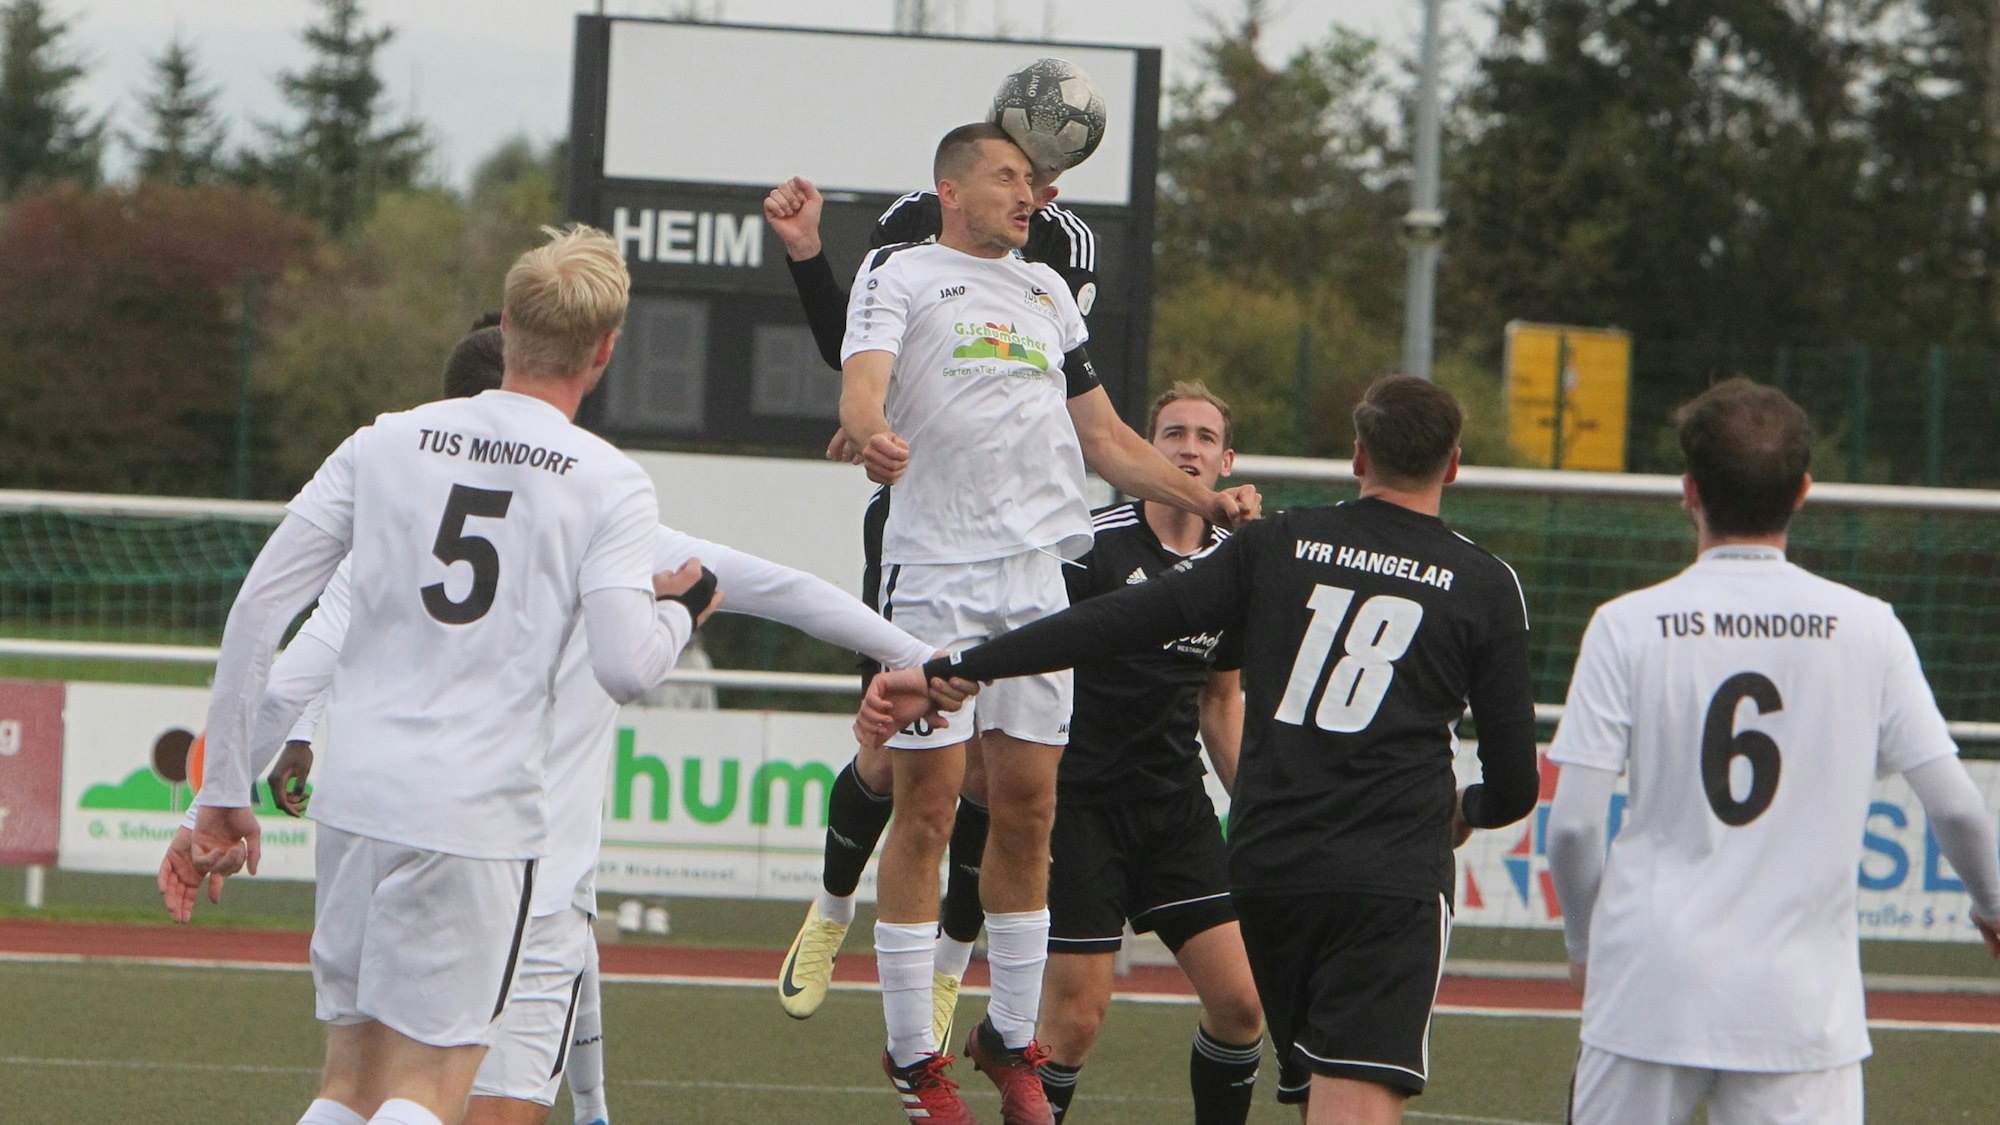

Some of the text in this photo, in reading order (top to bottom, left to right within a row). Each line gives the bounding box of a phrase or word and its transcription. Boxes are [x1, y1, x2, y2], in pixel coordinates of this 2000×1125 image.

[613, 206, 764, 268] HEIM
[940, 285, 966, 299] JAKO
[942, 364, 972, 377] Garten
[418, 428, 578, 476] TUS MONDORF
[420, 482, 513, 625] 5
[1295, 539, 1454, 591] VfR HANGELAR
[1656, 611, 1839, 640] TUS MONDORF
[1274, 583, 1423, 733] 18
[1701, 670, 1783, 827] 6
